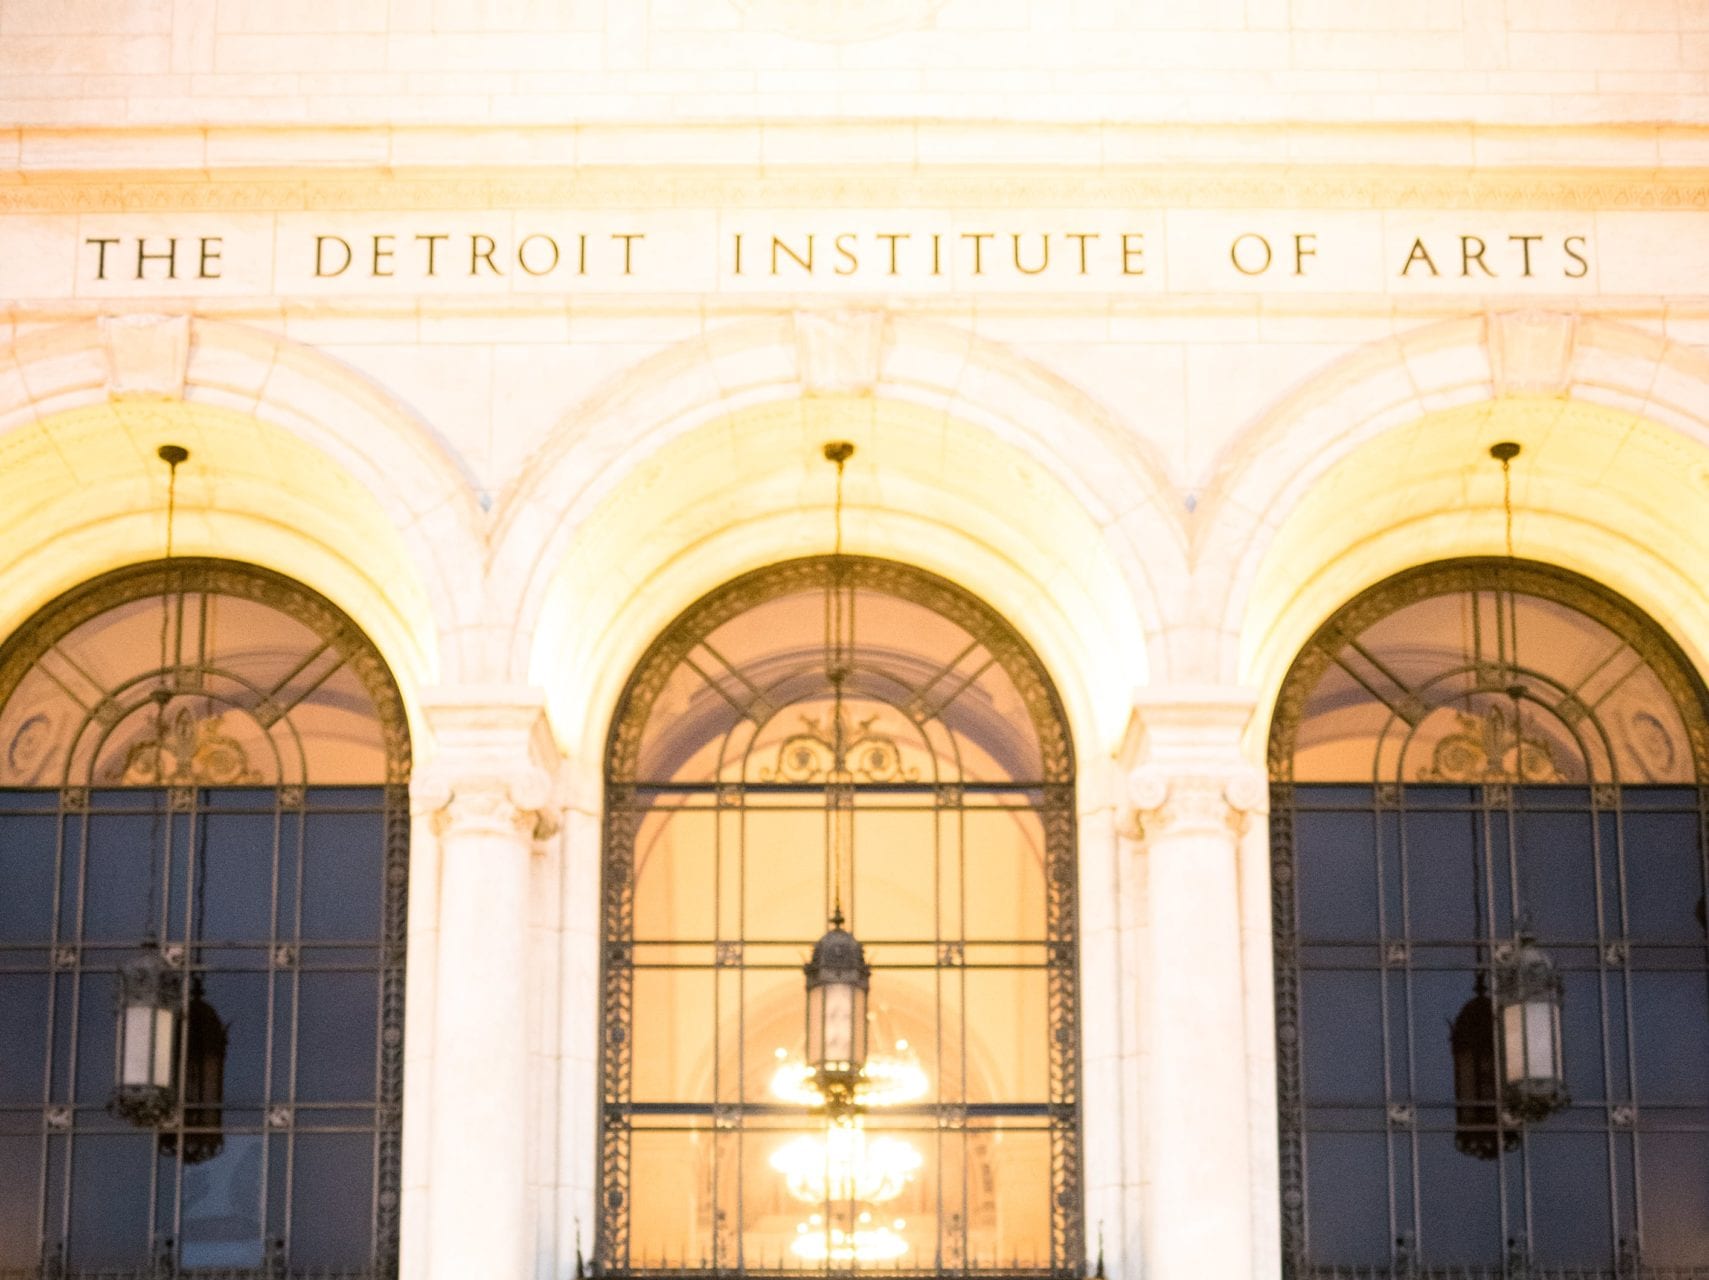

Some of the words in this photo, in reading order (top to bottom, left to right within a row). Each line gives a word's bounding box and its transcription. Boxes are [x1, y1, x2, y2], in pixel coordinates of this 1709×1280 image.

[85, 236, 222, 280] THE
[314, 234, 646, 277] DETROIT
[735, 233, 1146, 275] INSTITUTE
[1230, 233, 1318, 275] OF
[1401, 235, 1589, 278] ARTS
